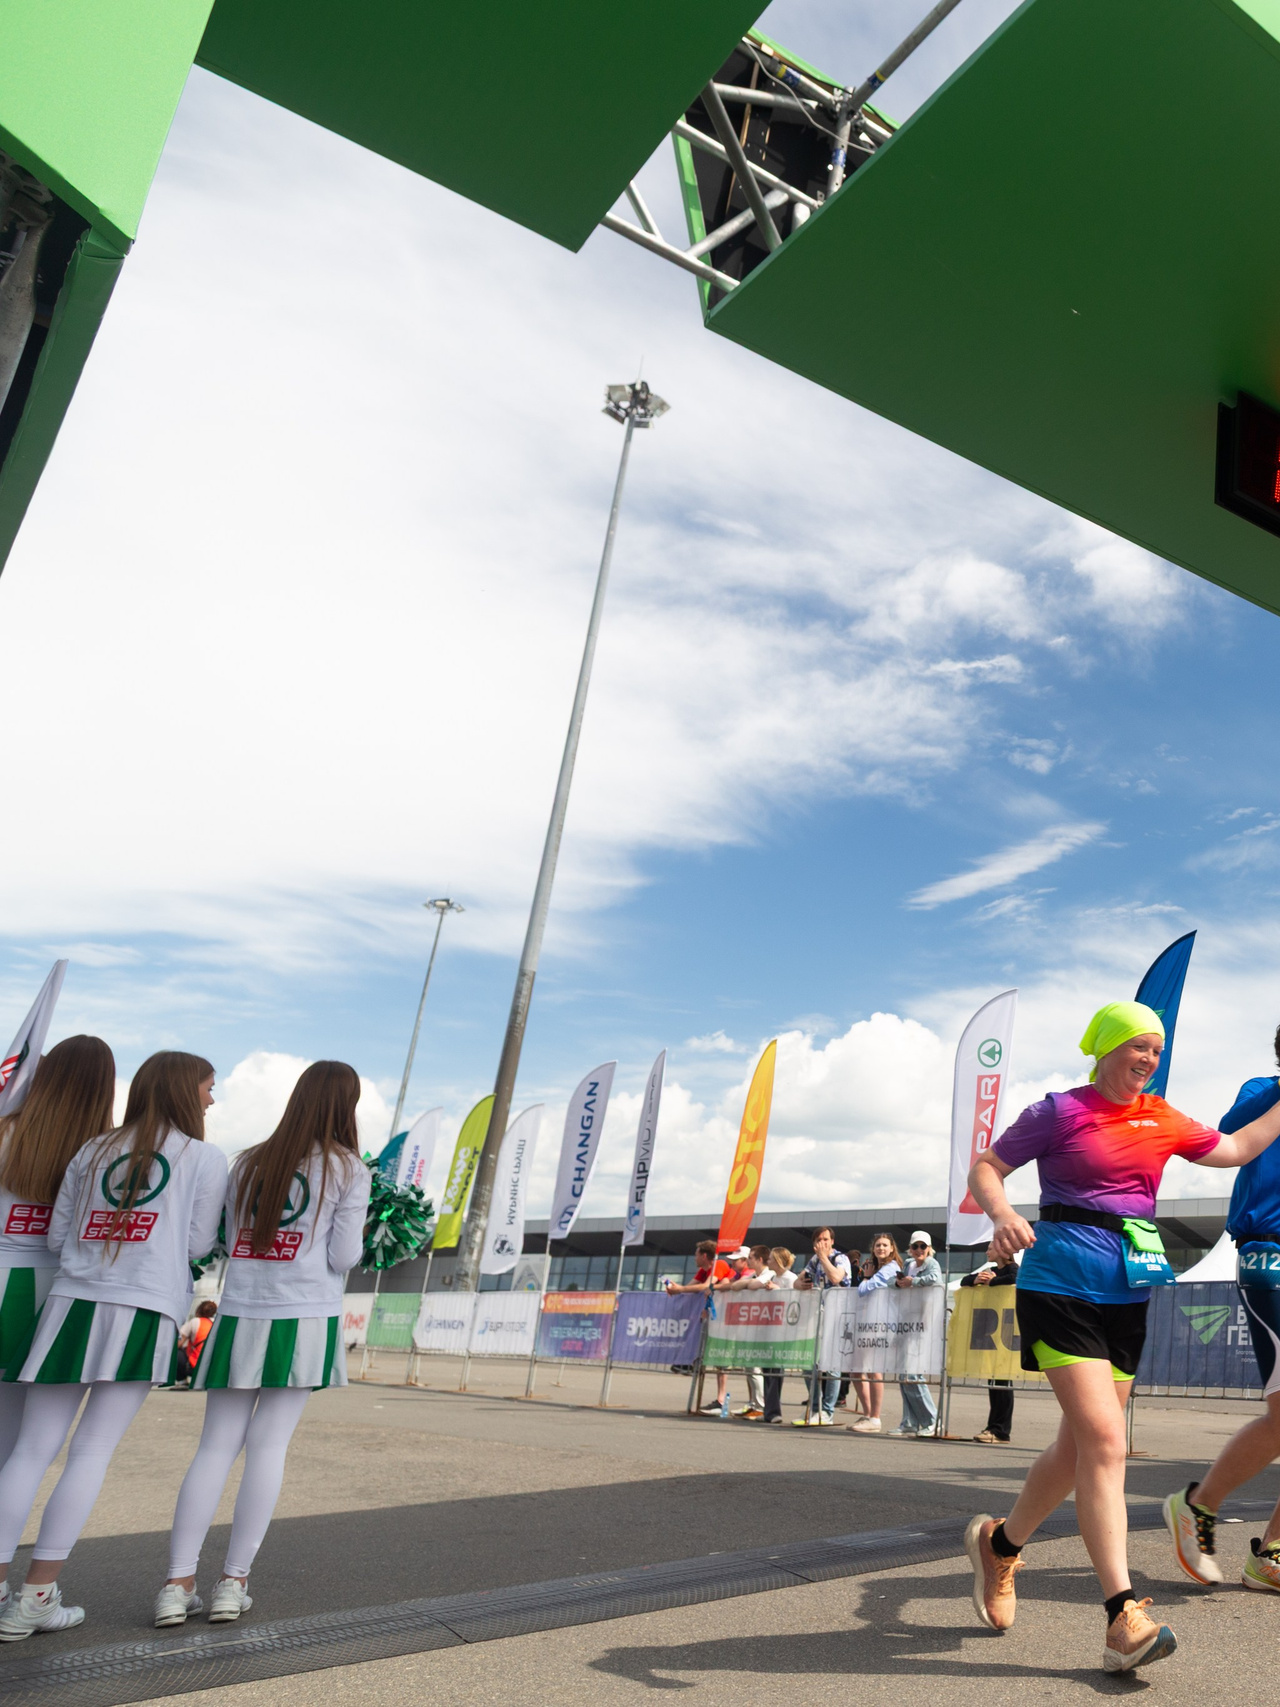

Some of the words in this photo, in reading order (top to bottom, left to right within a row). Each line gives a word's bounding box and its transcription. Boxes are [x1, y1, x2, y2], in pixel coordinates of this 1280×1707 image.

[975, 1076, 998, 1154] PAR
[571, 1081, 600, 1198] CHANGAN
[13, 1206, 49, 1218] EU
[8, 1221, 49, 1233] SPA
[240, 1230, 301, 1245] ERO
[738, 1305, 785, 1322] SPAR
[857, 1322, 925, 1335] НИЖЕГОРОДСКАЯ
[857, 1338, 890, 1348] ОБЛАСТЬ
